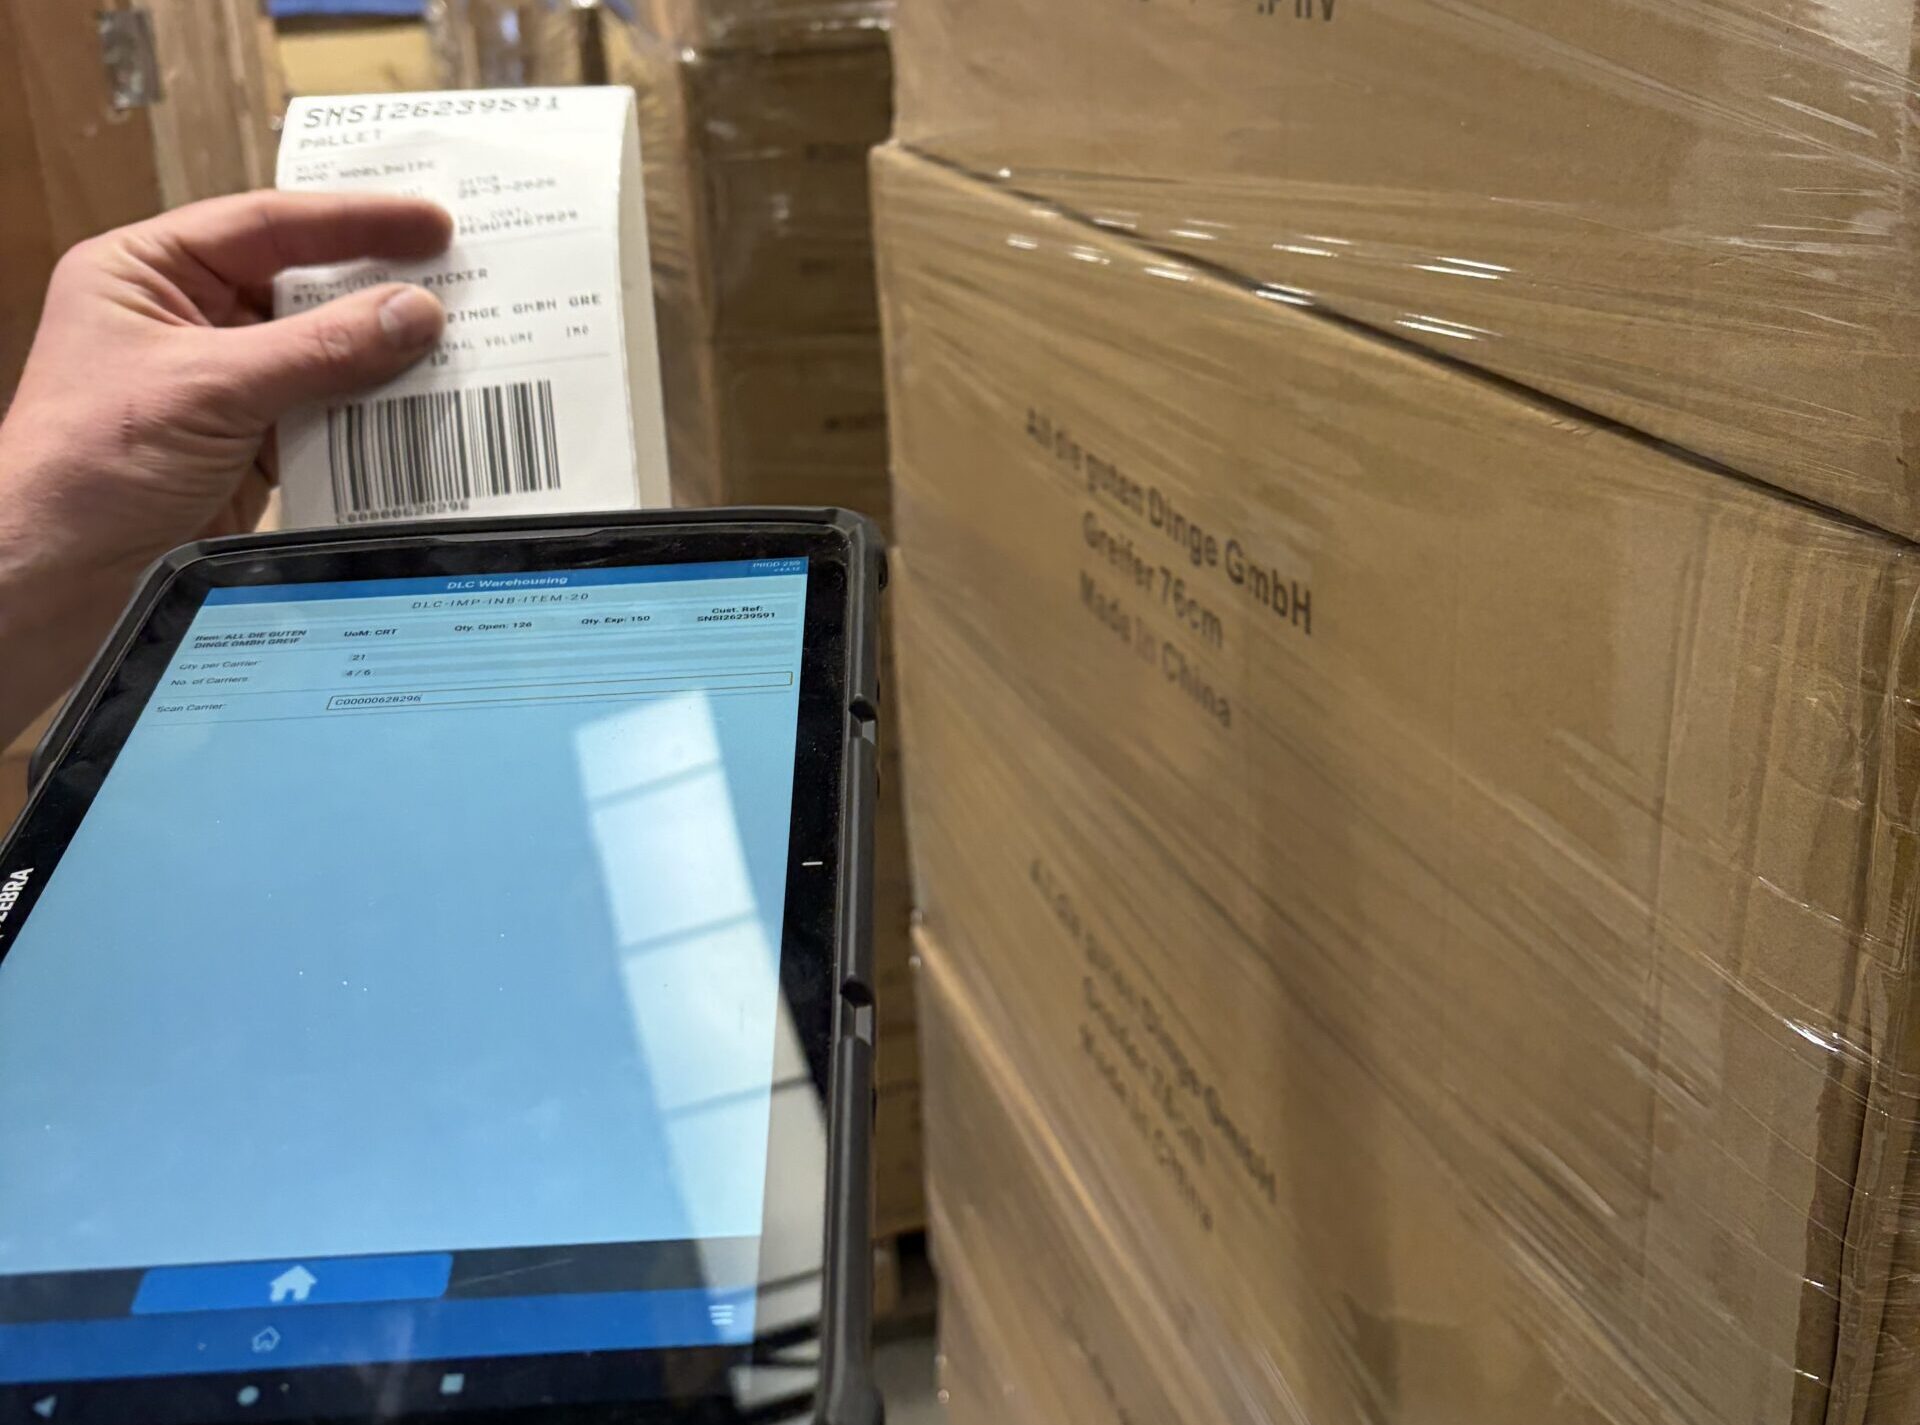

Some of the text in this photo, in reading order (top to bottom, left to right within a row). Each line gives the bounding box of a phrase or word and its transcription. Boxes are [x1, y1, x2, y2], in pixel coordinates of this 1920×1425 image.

[303, 96, 559, 129] SNSI26239591
[422, 268, 488, 288] PICKER
[1147, 485, 1219, 568] Dinge
[1224, 537, 1313, 637] GmbH
[447, 576, 569, 590] DLC Warehousing
[411, 592, 590, 610] DLC-IMP-INB-ITEM-20
[711, 605, 764, 615] Cust. Ref:
[1158, 564, 1224, 651] 76cm
[604, 615, 628, 626] Exp:
[697, 611, 776, 622] SNSI26239591
[374, 628, 399, 636] CRT
[477, 622, 509, 632] Open:
[512, 621, 533, 629] 126
[223, 632, 245, 640] ALL
[247, 631, 268, 639] DIE
[268, 629, 308, 638] GUTEN
[194, 637, 302, 649] DINGE GMBH GREIF
[206, 676, 250, 684] Carriers
[157, 705, 184, 713] Scan
